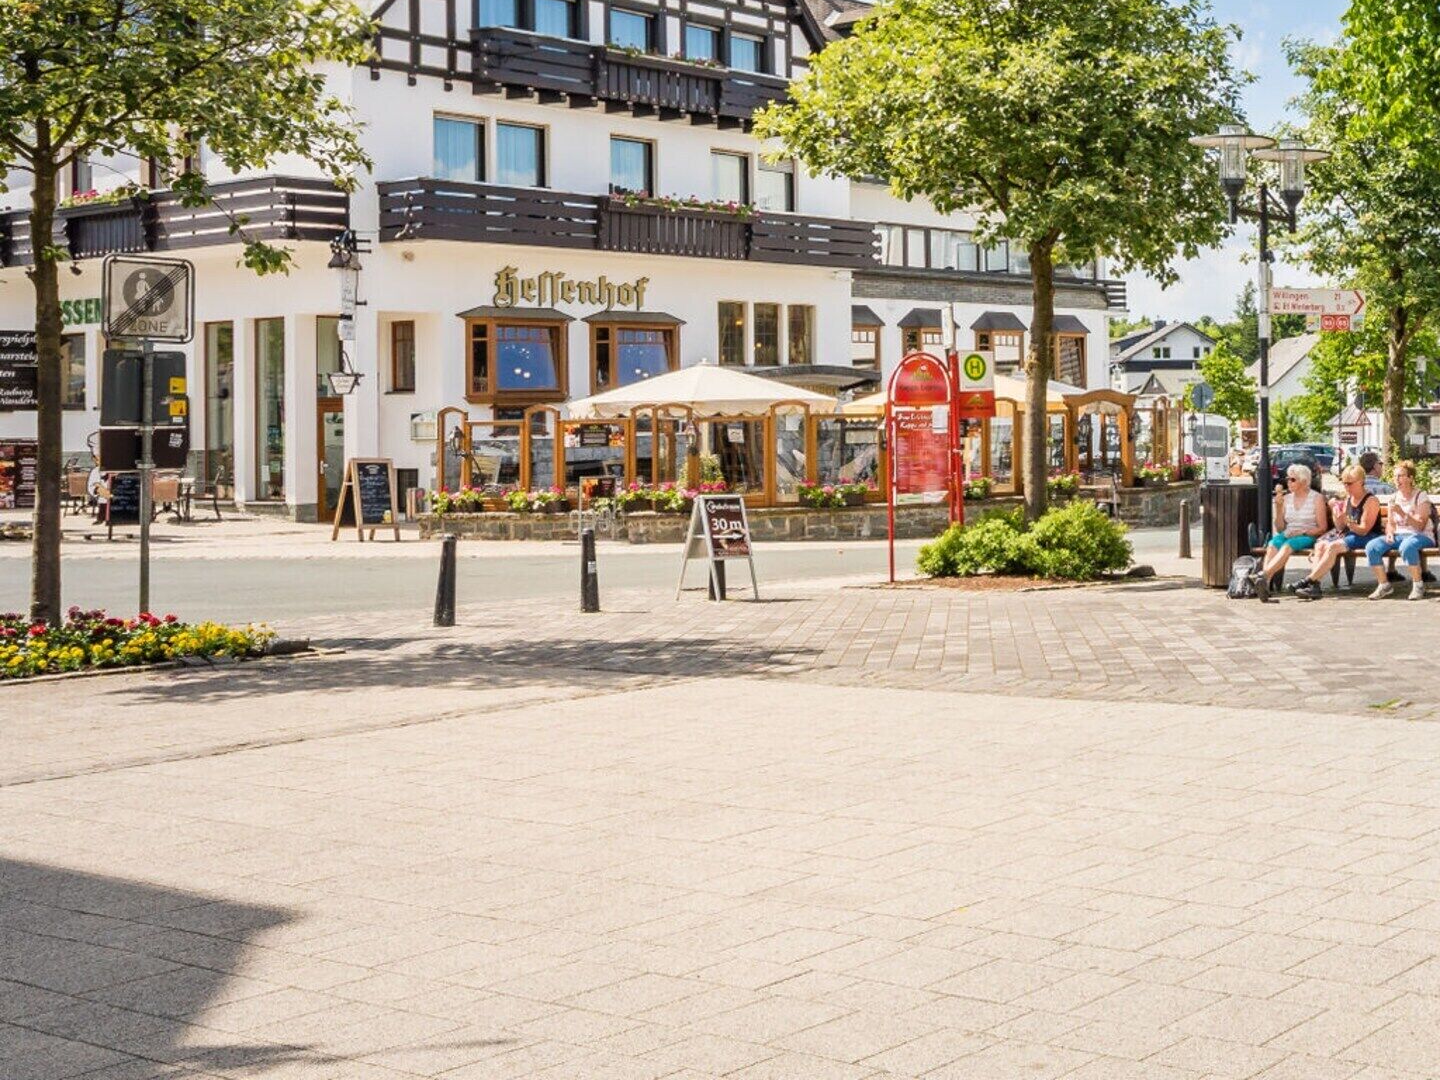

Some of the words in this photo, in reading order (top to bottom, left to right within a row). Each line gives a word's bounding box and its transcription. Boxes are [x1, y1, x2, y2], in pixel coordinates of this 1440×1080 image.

[130, 320, 168, 333] ZONE
[711, 518, 728, 531] 30
[730, 521, 742, 530] m
